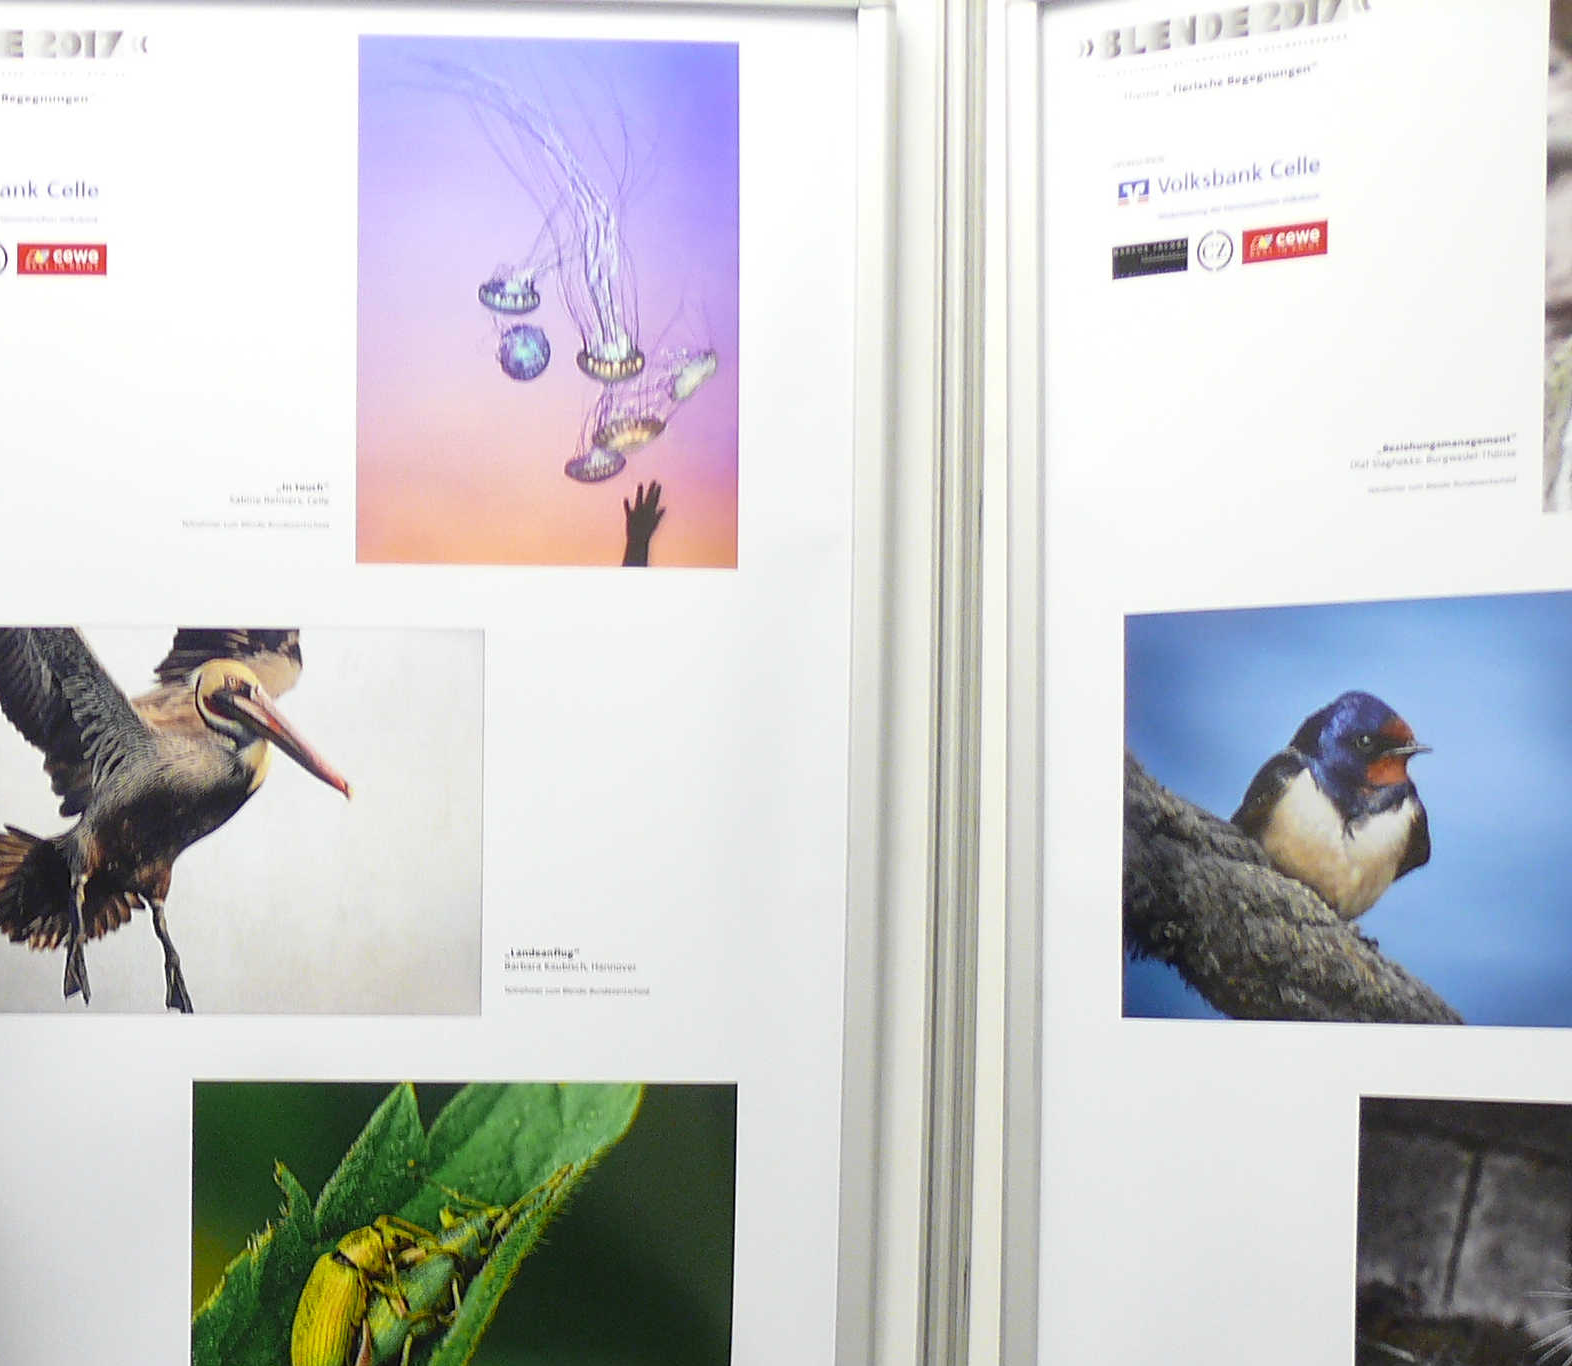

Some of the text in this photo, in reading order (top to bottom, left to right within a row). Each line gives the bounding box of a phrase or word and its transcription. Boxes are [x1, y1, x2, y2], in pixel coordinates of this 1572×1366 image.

[36, 29, 124, 58] 2017
[1157, 155, 1321, 195] Volksbank Celle
[47, 180, 100, 199] Celle
[1275, 227, 1321, 246] cewe
